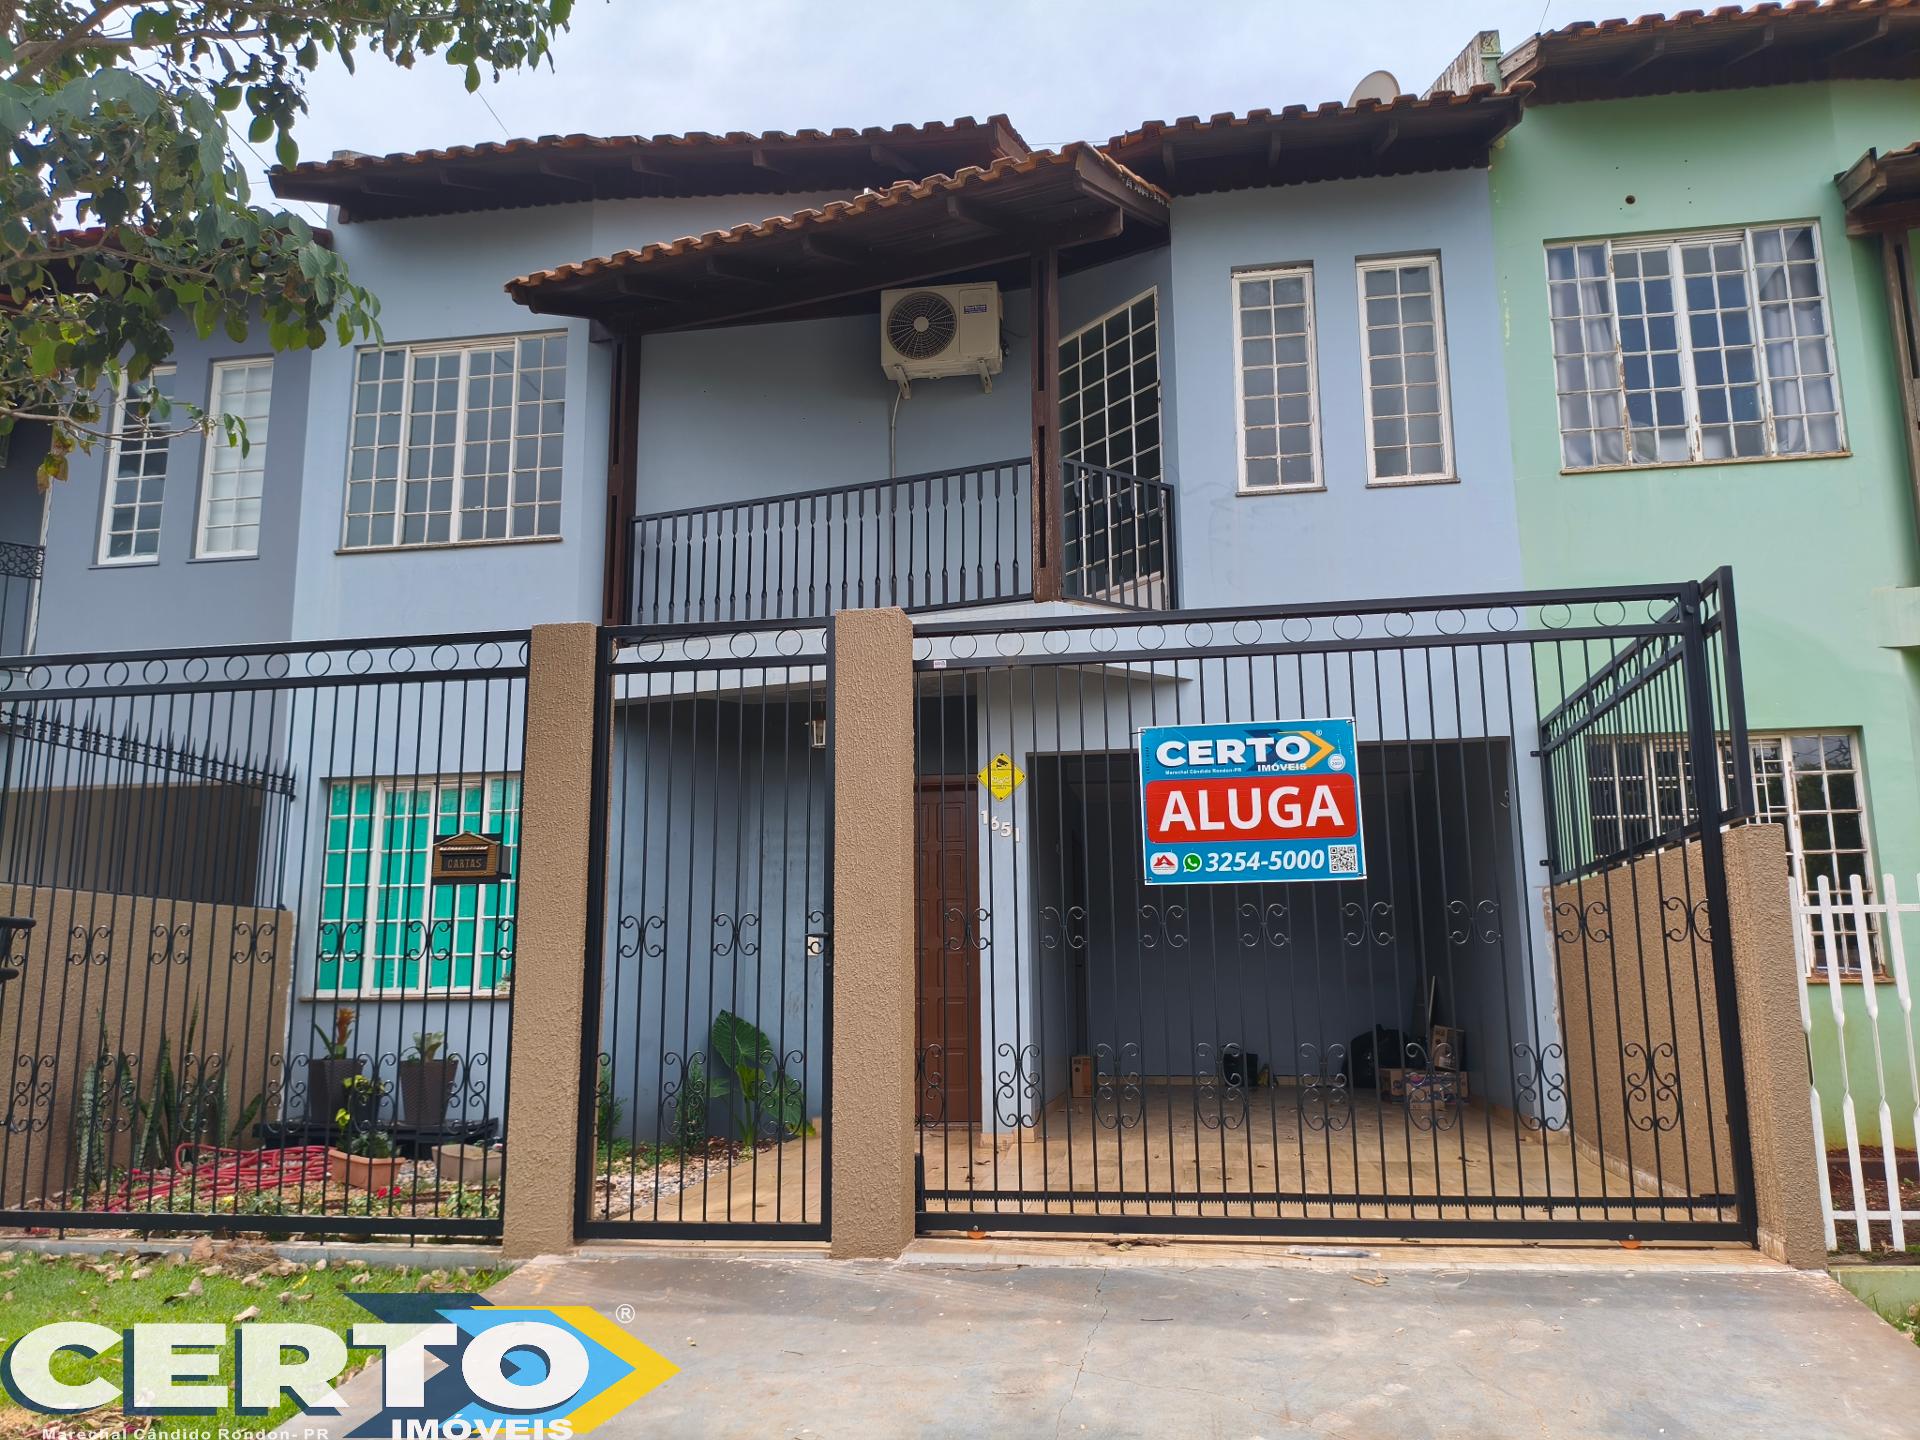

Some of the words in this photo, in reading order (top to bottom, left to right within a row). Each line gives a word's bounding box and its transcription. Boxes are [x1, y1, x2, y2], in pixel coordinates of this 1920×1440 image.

[1155, 735, 1311, 767] CERTO
[1257, 762, 1308, 773] IMÓVEIS
[1158, 784, 1345, 833] ALUGA
[1204, 849, 1325, 873] 3254-5000
